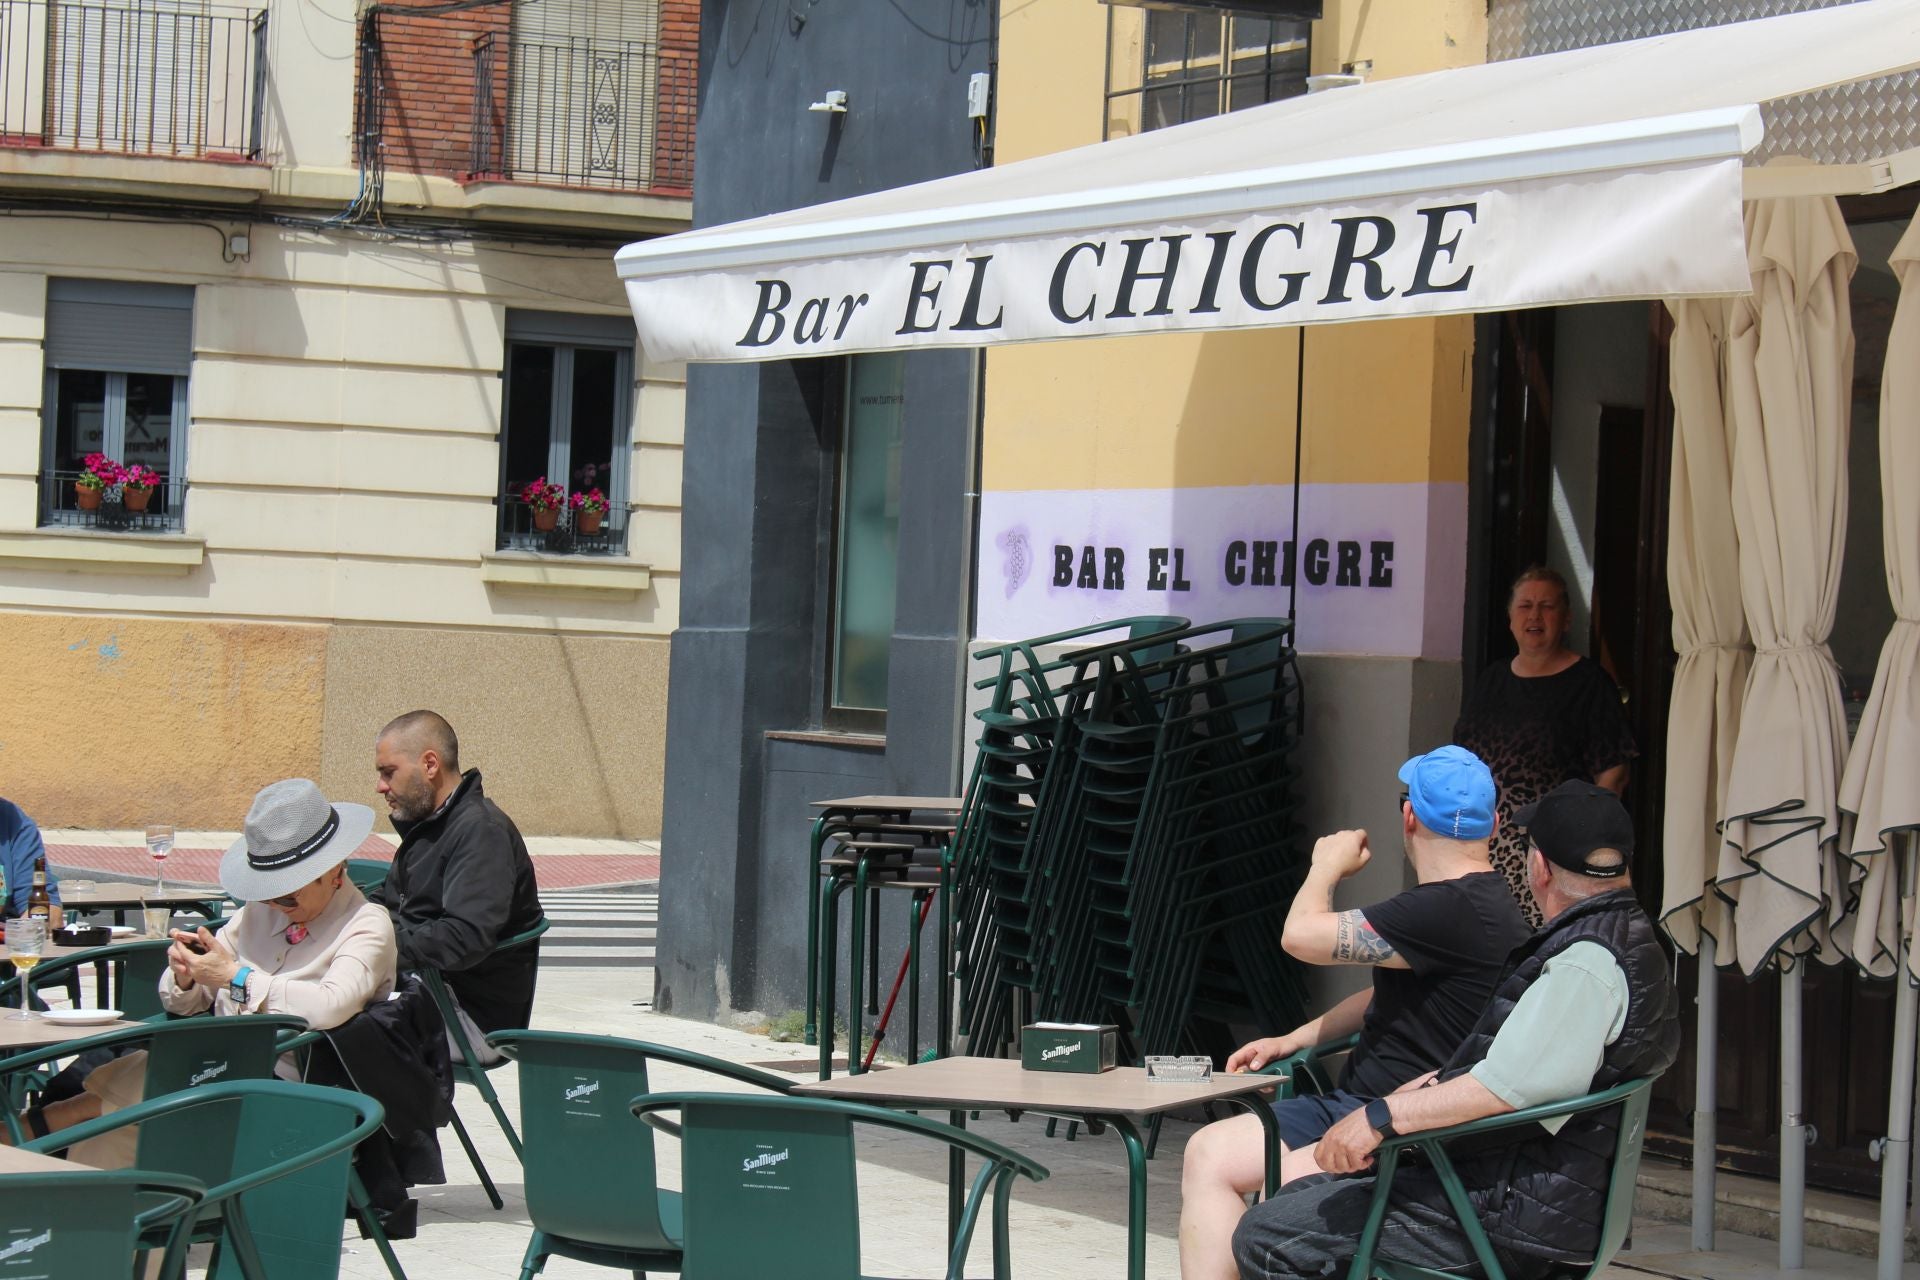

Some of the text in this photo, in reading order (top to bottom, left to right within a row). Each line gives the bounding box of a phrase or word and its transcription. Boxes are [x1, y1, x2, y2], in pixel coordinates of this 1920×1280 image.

[736, 203, 1477, 346] Bar EL CHIGRE
[1053, 538, 1394, 591] BAR EL CHIGRE
[1041, 1041, 1081, 1061] SanMiguel
[565, 1080, 599, 1100] SanMiguel
[742, 1148, 789, 1171] SanMiguel
